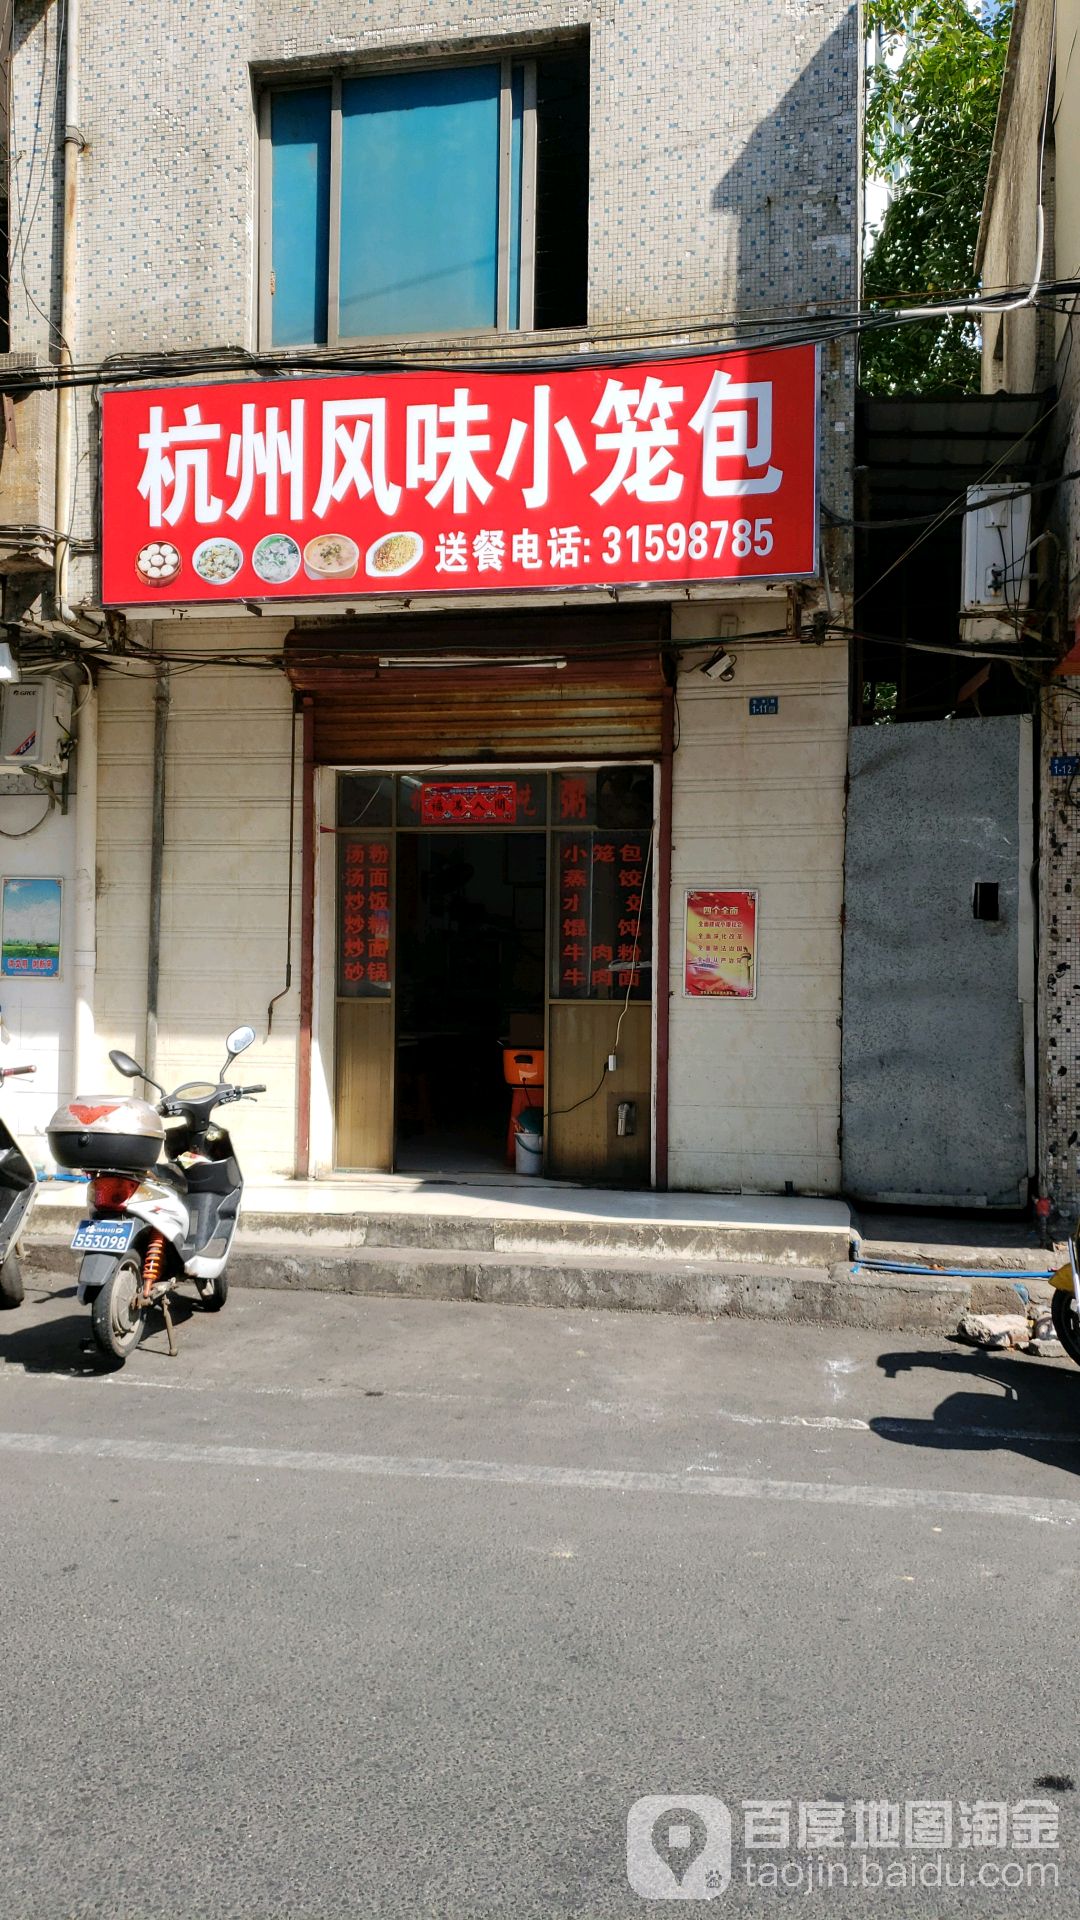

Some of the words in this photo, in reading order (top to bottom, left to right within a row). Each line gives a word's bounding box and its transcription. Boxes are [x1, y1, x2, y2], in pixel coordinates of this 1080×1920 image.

[136, 370, 783, 527] 杭州风味小笼包
[435, 525, 591, 574] 送餐电话:
[602, 518, 774, 565] 31598785
[563, 843, 642, 863] 小笼包
[344, 868, 390, 887] 汤面
[344, 891, 390, 911] 炒饭
[703, 906, 738, 916] 四个全面
[344, 937, 390, 958] 炒面
[563, 943, 641, 961] 牛肉粉
[563, 968, 641, 986] 牛肉面
[75, 1233, 126, 1250] 553098
